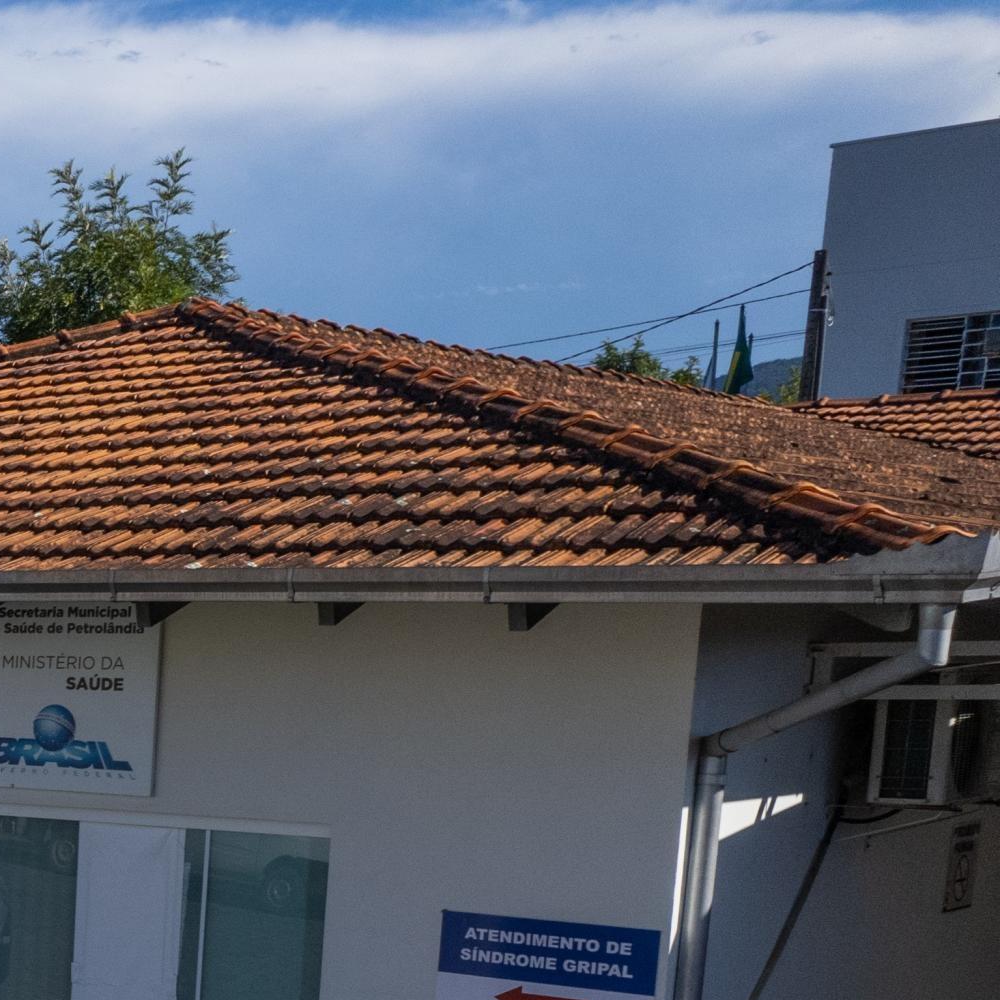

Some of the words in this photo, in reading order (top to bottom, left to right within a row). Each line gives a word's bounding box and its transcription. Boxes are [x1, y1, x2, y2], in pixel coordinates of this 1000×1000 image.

[68, 606, 131, 621] Municipal
[4, 621, 43, 634] Saúde
[47, 622, 64, 634] de
[67, 622, 144, 634] Petrolândia
[2, 652, 95, 670] MINISTÉRIO
[101, 656, 125, 671] DA
[66, 673, 124, 691] SAÚDE
[464, 927, 600, 953] ATENDIMENTO
[606, 941, 633, 956] DE
[460, 946, 557, 970] SÍNDROME
[563, 959, 634, 979] GRIPAL
